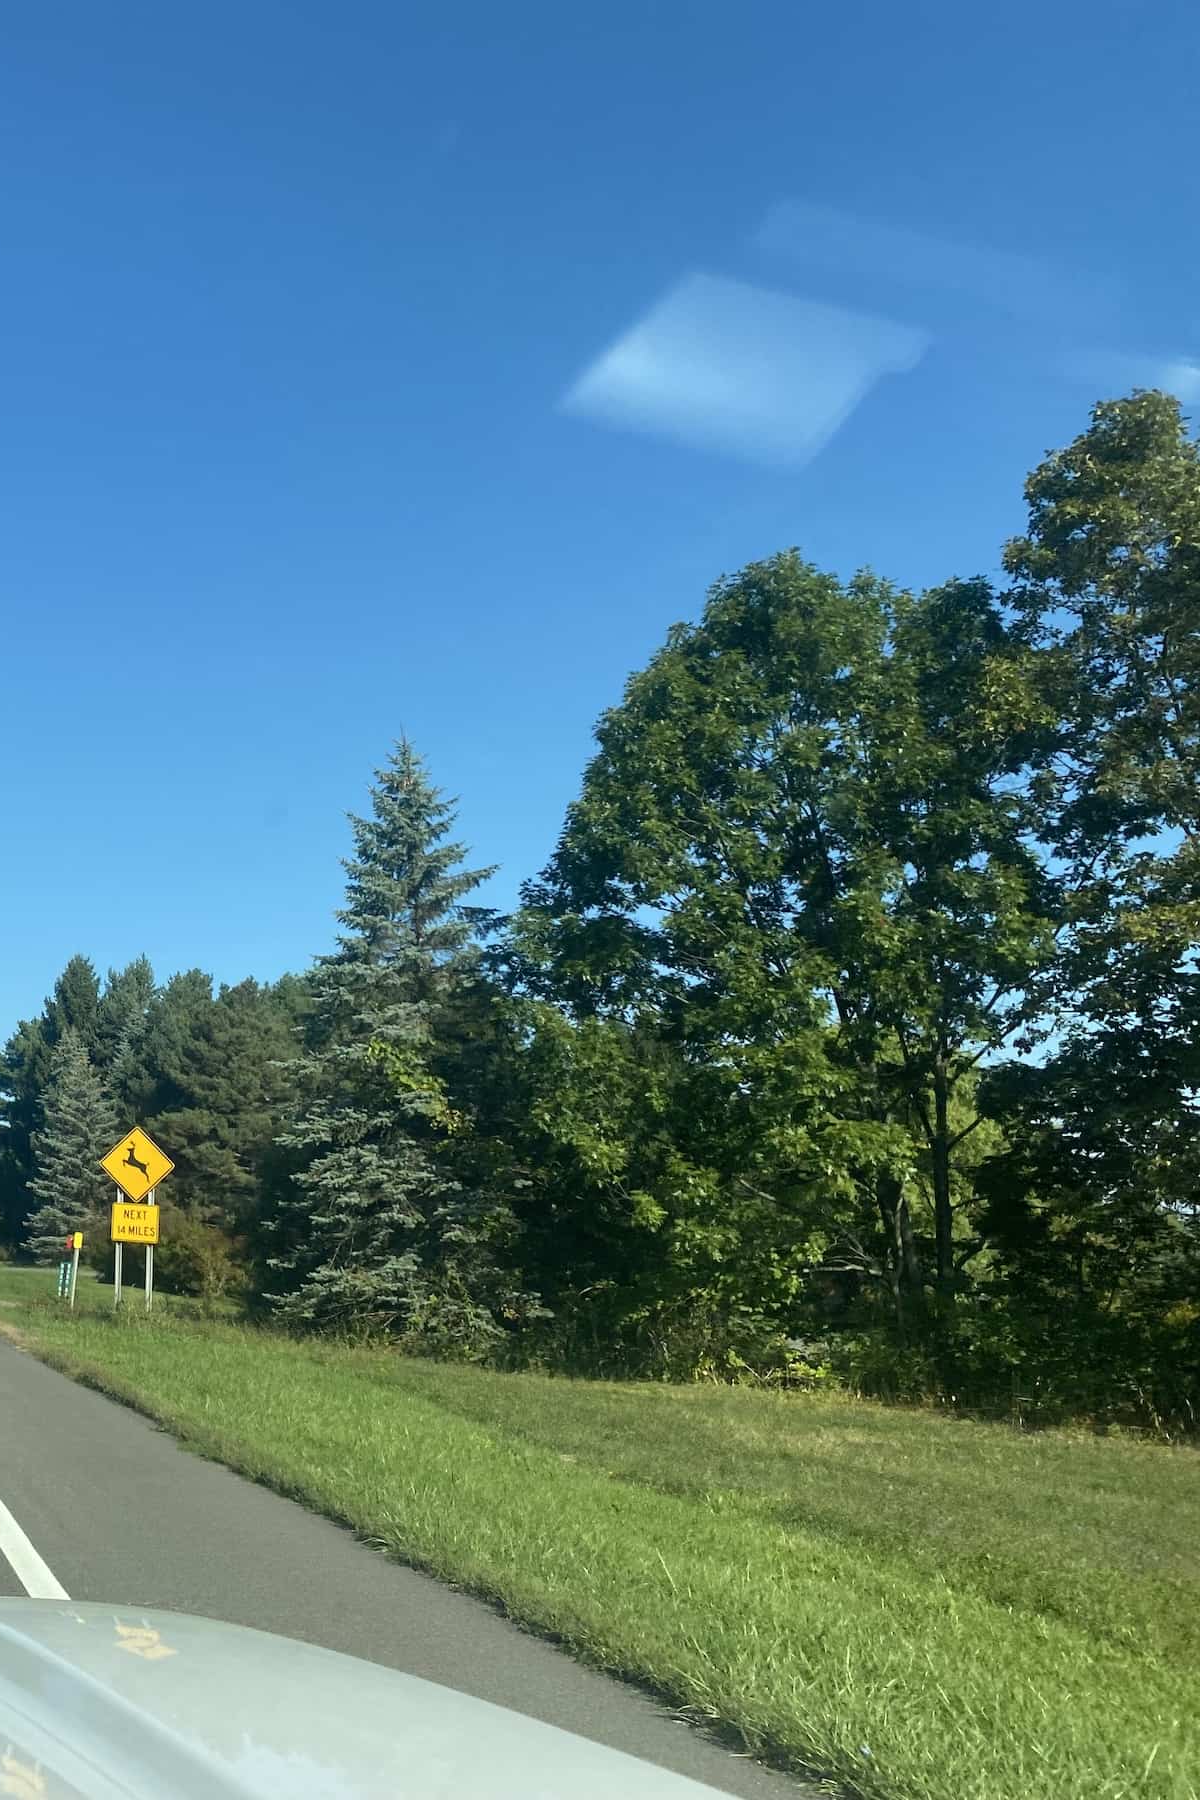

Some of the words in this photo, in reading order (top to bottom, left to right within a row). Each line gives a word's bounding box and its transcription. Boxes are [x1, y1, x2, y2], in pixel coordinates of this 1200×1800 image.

[123, 1209, 147, 1220] NEXT
[117, 1225, 126, 1234] 14
[128, 1226, 155, 1237] MILES
